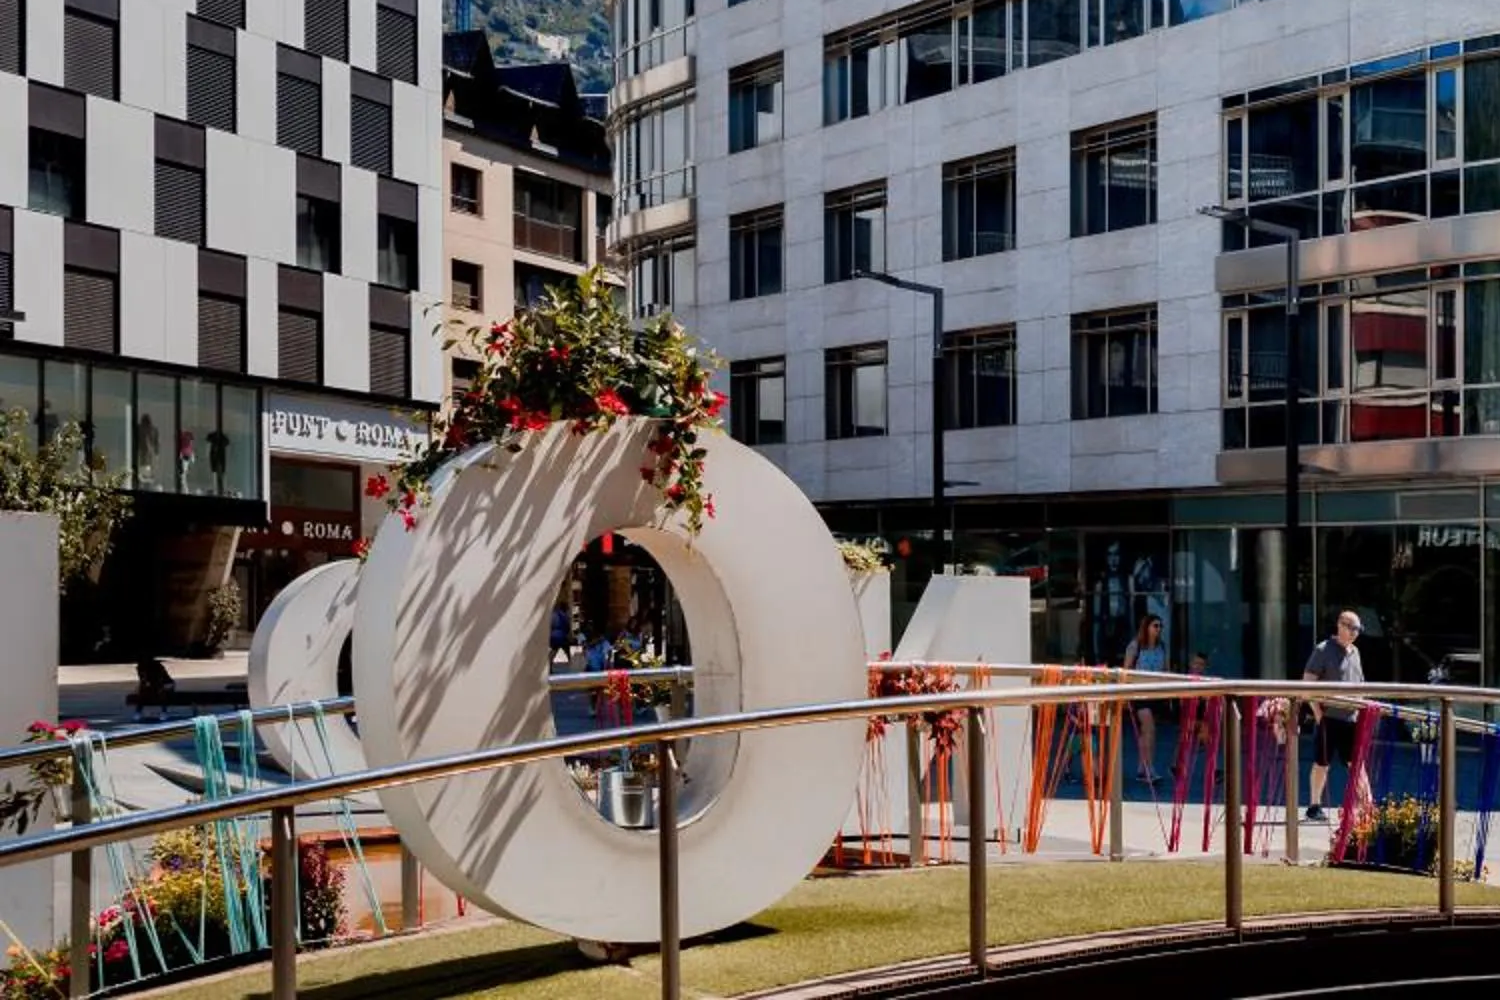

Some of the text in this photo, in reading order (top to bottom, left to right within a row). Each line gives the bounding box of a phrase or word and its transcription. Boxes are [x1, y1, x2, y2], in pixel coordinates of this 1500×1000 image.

[272, 410, 412, 450] PUNT ROMA
[303, 521, 354, 541] ROMA
